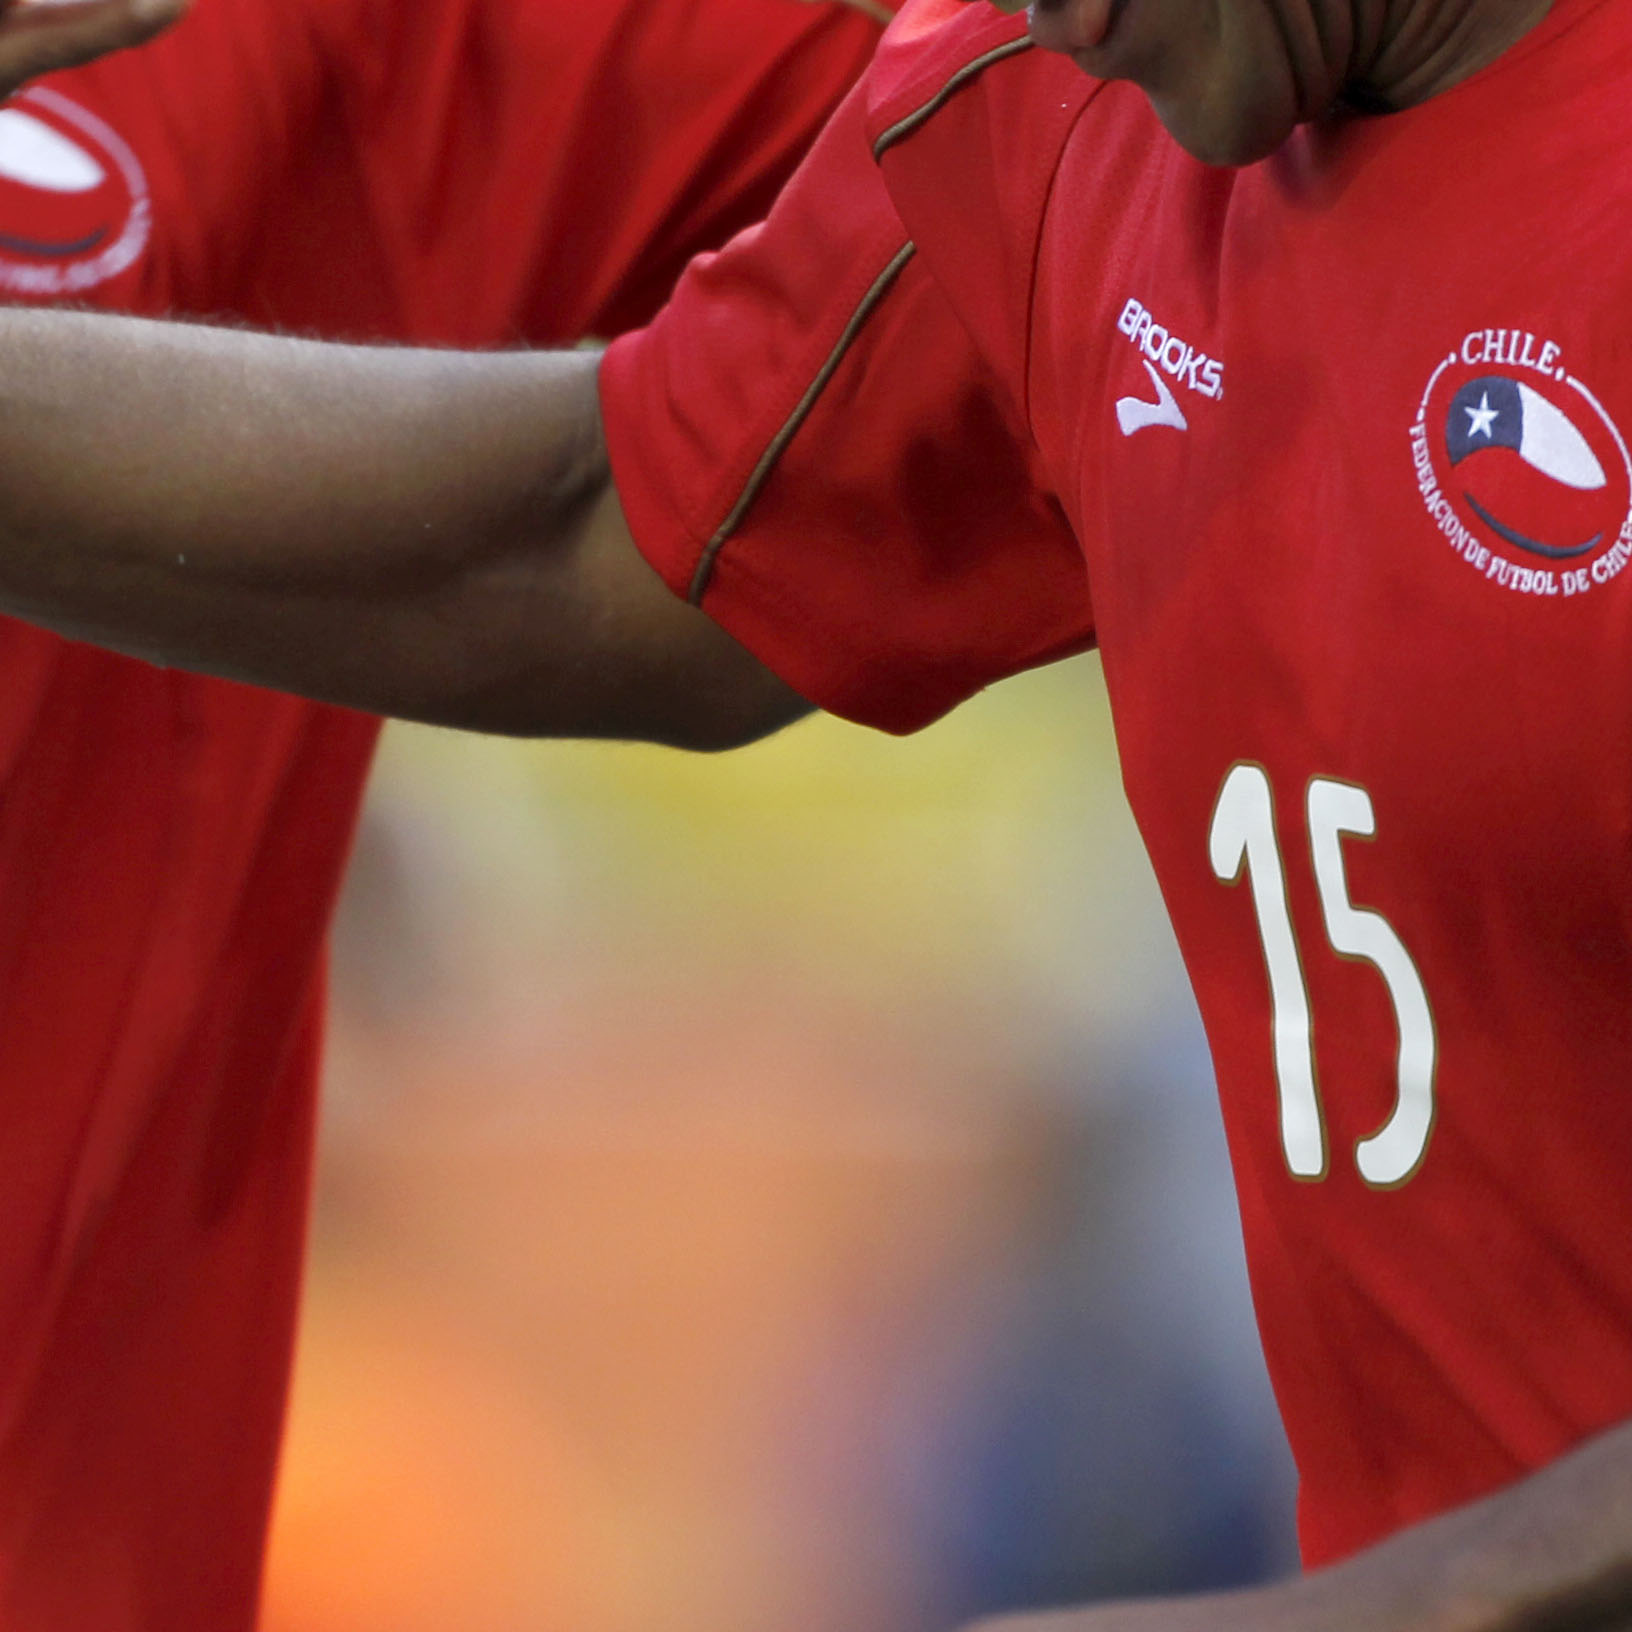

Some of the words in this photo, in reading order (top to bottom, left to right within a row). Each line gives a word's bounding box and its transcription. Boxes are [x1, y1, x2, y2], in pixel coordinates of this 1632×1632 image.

[1117, 297, 1224, 398] BROOKS
[1461, 328, 1561, 374] CHILE
[1464, 538, 1490, 570] DE
[1485, 556, 1558, 596] FUTBOL
[1561, 569, 1590, 597] DE
[1208, 762, 1437, 1189] 15
